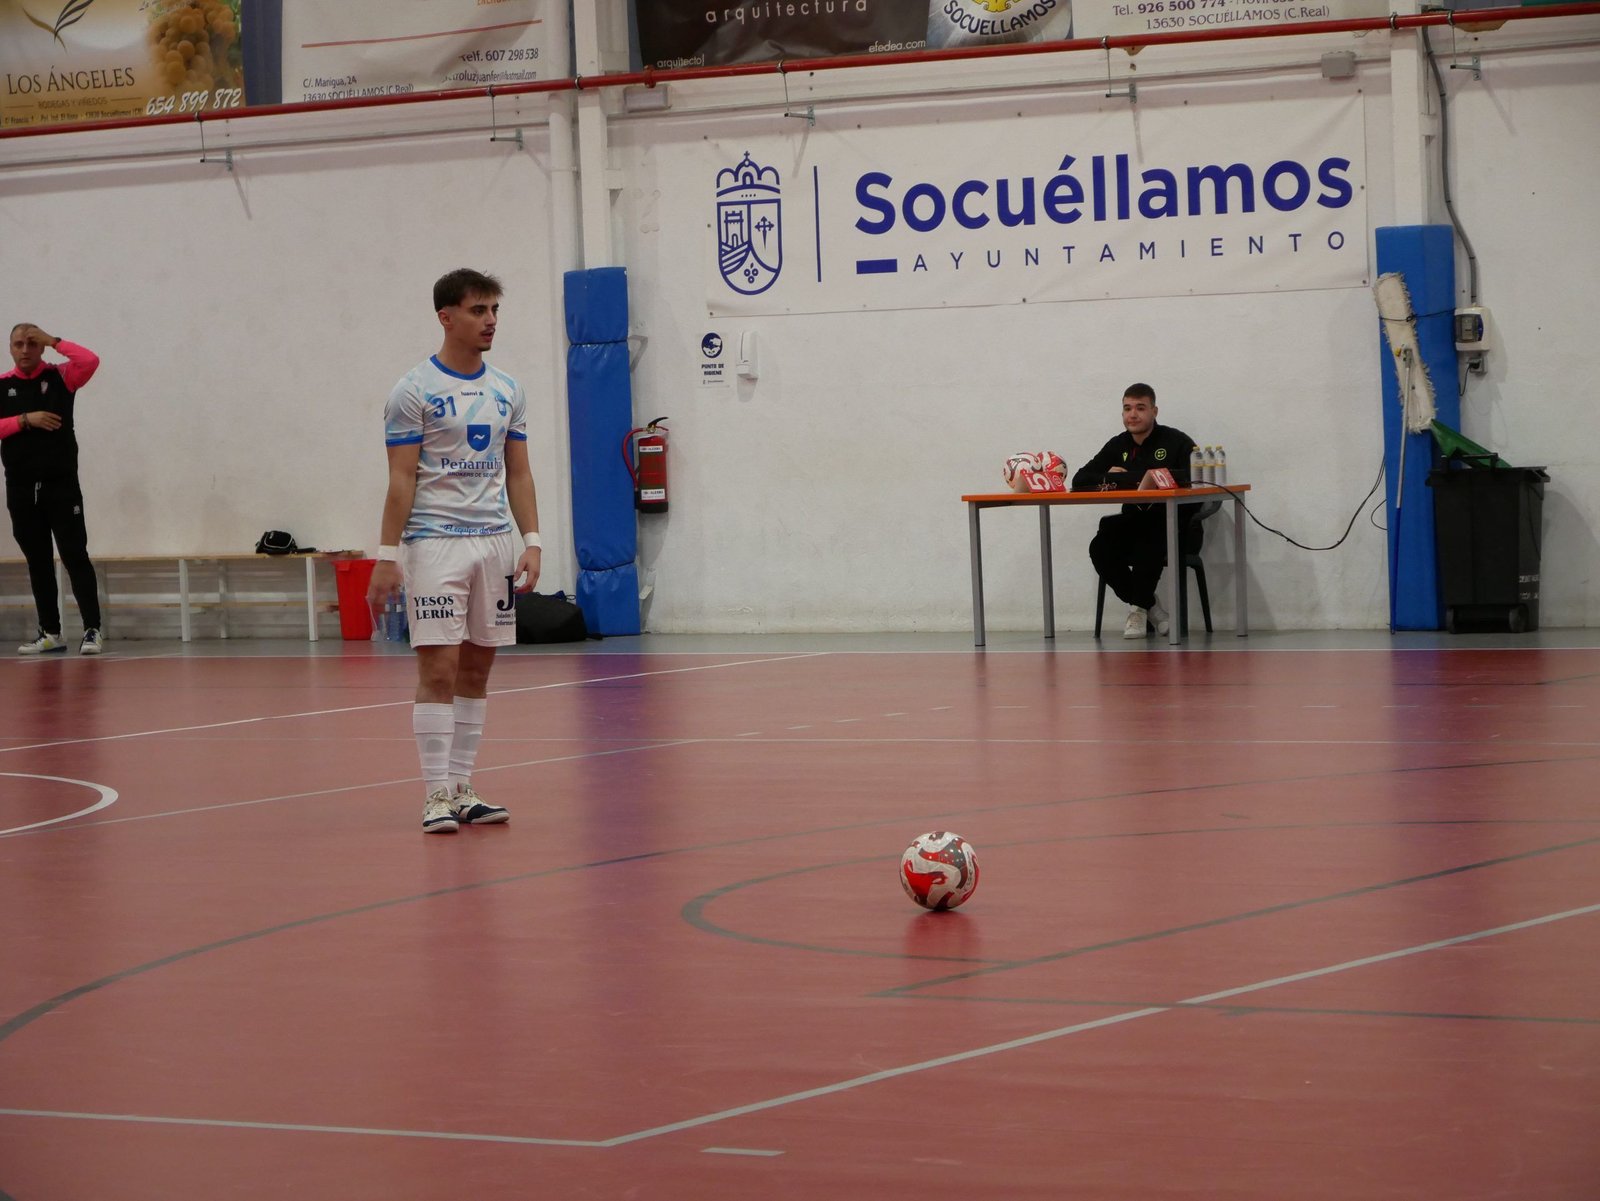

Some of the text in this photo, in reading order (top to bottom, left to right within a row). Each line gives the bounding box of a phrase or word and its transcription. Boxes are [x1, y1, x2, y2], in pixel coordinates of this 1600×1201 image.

[706, 0, 867, 24] arquitectura
[1113, 5, 1133, 16] Tel.
[1138, 3, 1164, 14] 926
[1169, 0, 1196, 11] 500
[1201, 0, 1226, 8] 774
[1147, 17, 1185, 30] 13630
[1189, 8, 1281, 26] SOCUÉLLAMOS
[486, 50, 505, 62] 607
[508, 49, 524, 61] 298
[525, 48, 539, 60] 538
[869, 40, 926, 53] efedea.com
[7, 65, 135, 95] LOS ÁNGELES
[146, 87, 242, 116] 654 899 872
[854, 153, 1354, 236] Socuéllamos
[912, 231, 1346, 273] AYUNTAMIENTO
[429, 395, 457, 418] 31
[414, 595, 454, 607] YESOS
[415, 606, 454, 620] LERÍN
